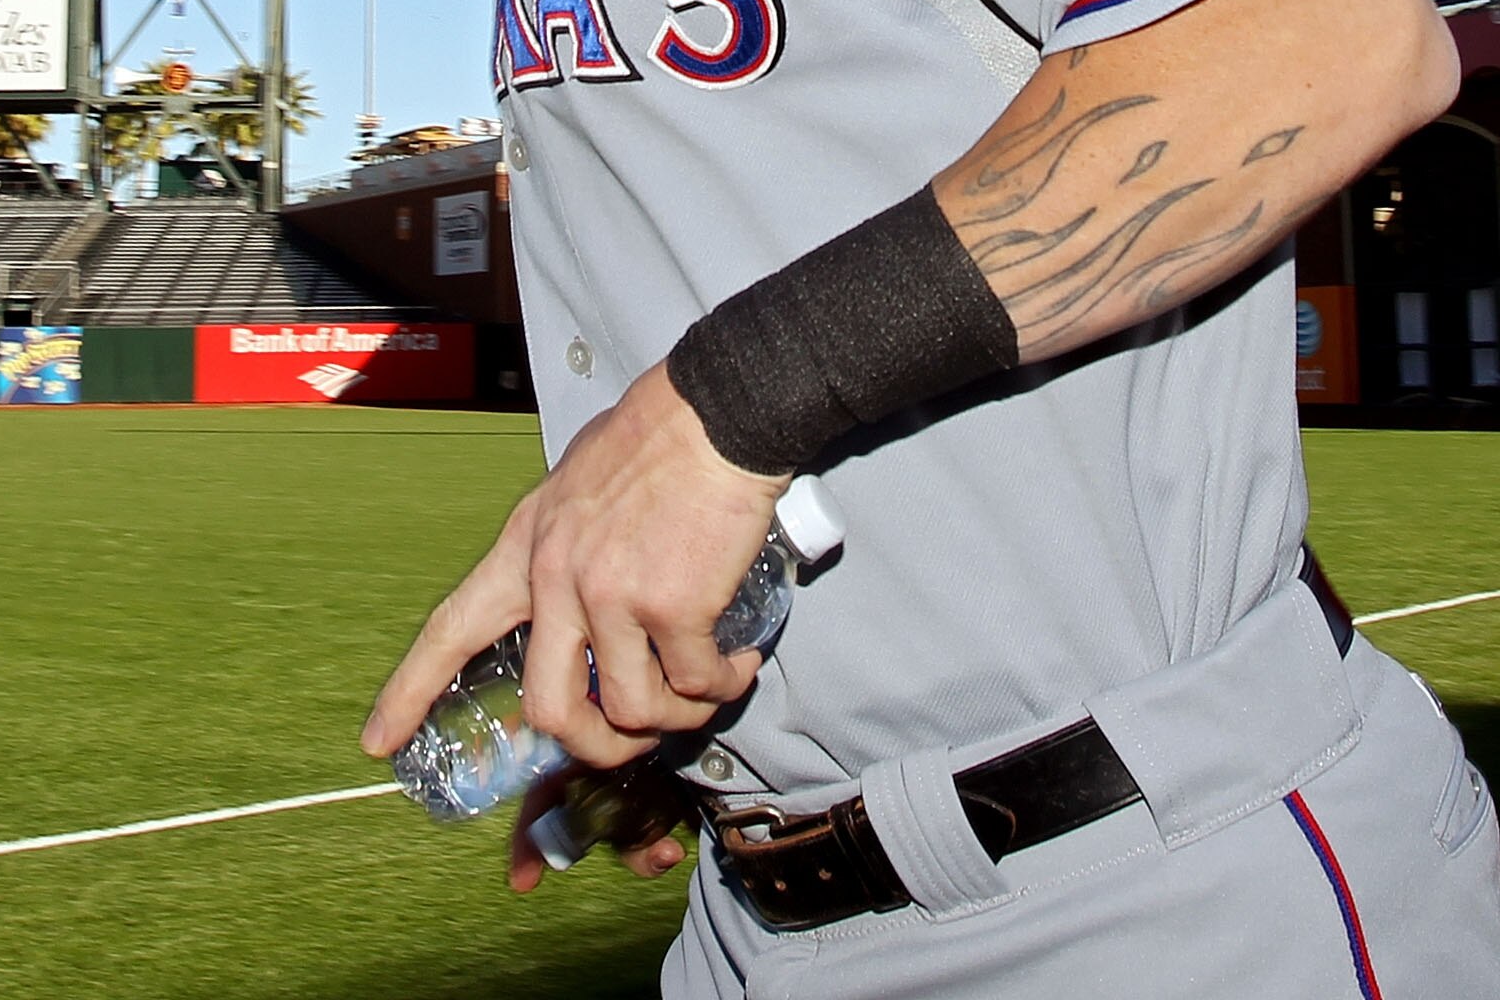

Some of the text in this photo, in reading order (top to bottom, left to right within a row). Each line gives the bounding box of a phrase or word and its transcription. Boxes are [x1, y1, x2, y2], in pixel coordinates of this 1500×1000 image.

[230, 327, 440, 353] Bank of America
